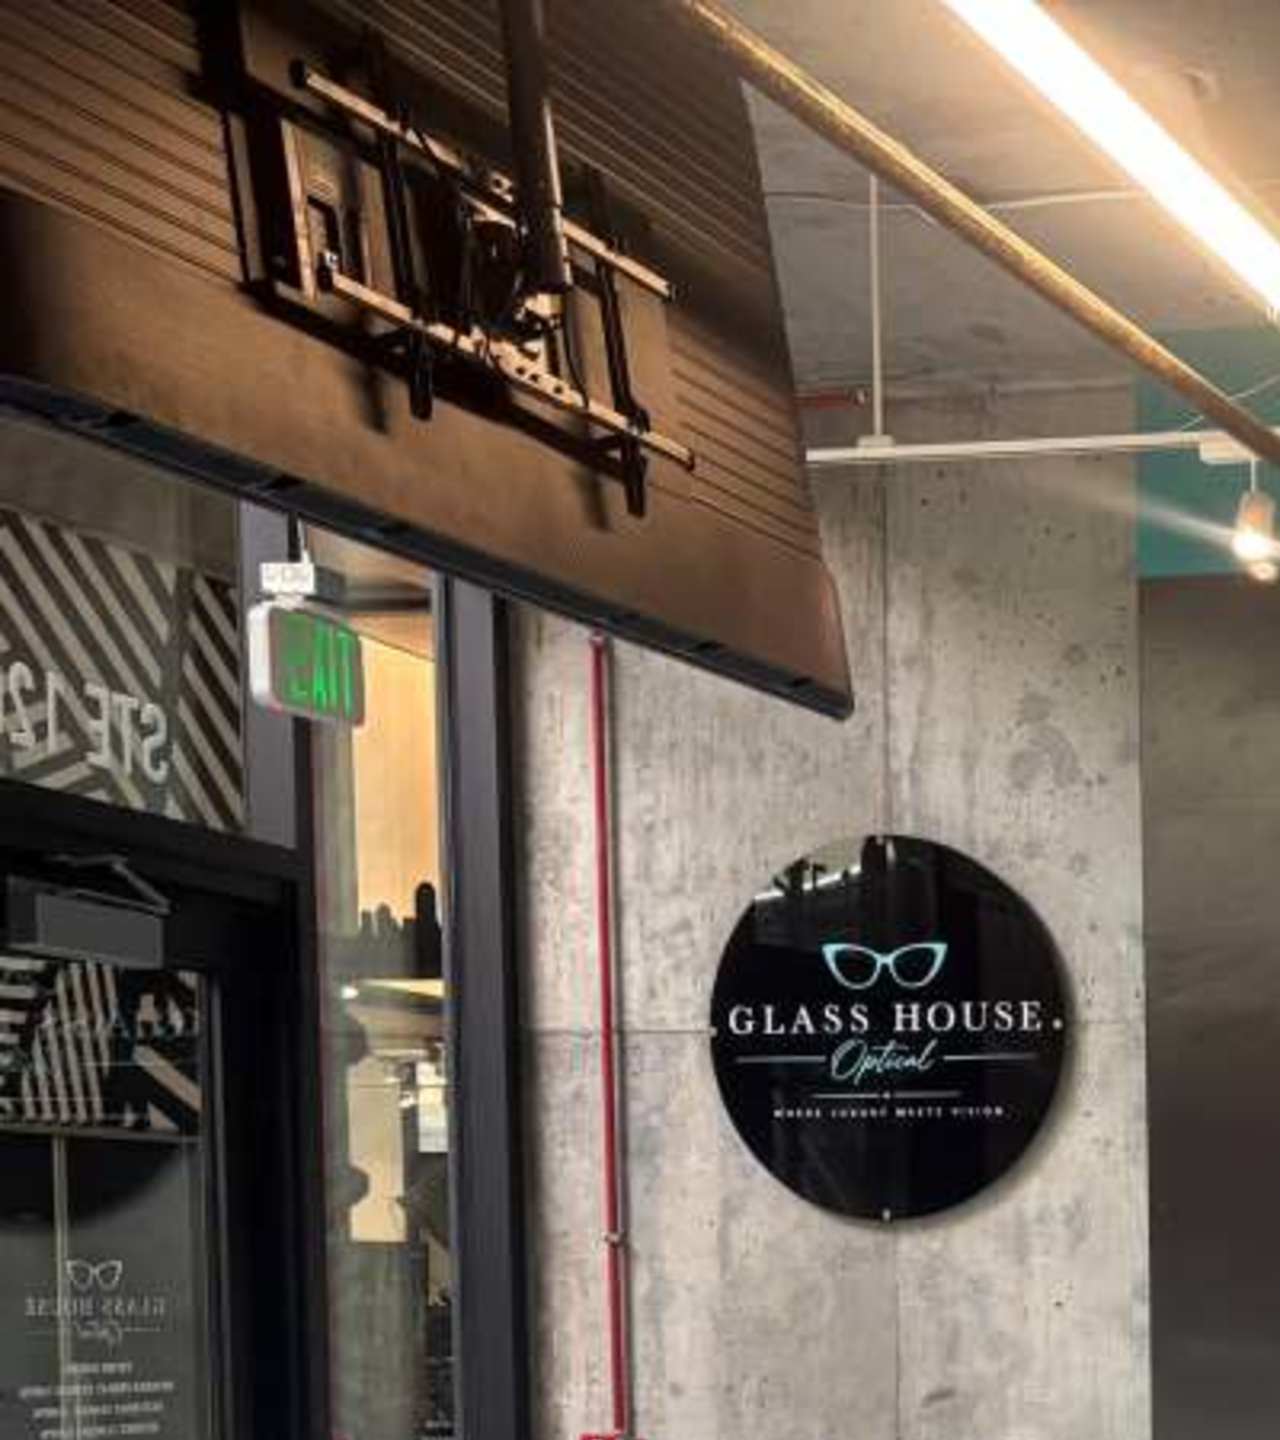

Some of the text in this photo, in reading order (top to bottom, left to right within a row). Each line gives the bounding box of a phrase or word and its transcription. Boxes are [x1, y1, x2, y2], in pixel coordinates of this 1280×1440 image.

[727, 1000, 1043, 1036] GLASS HOUSE
[831, 1038, 938, 1085] Optical
